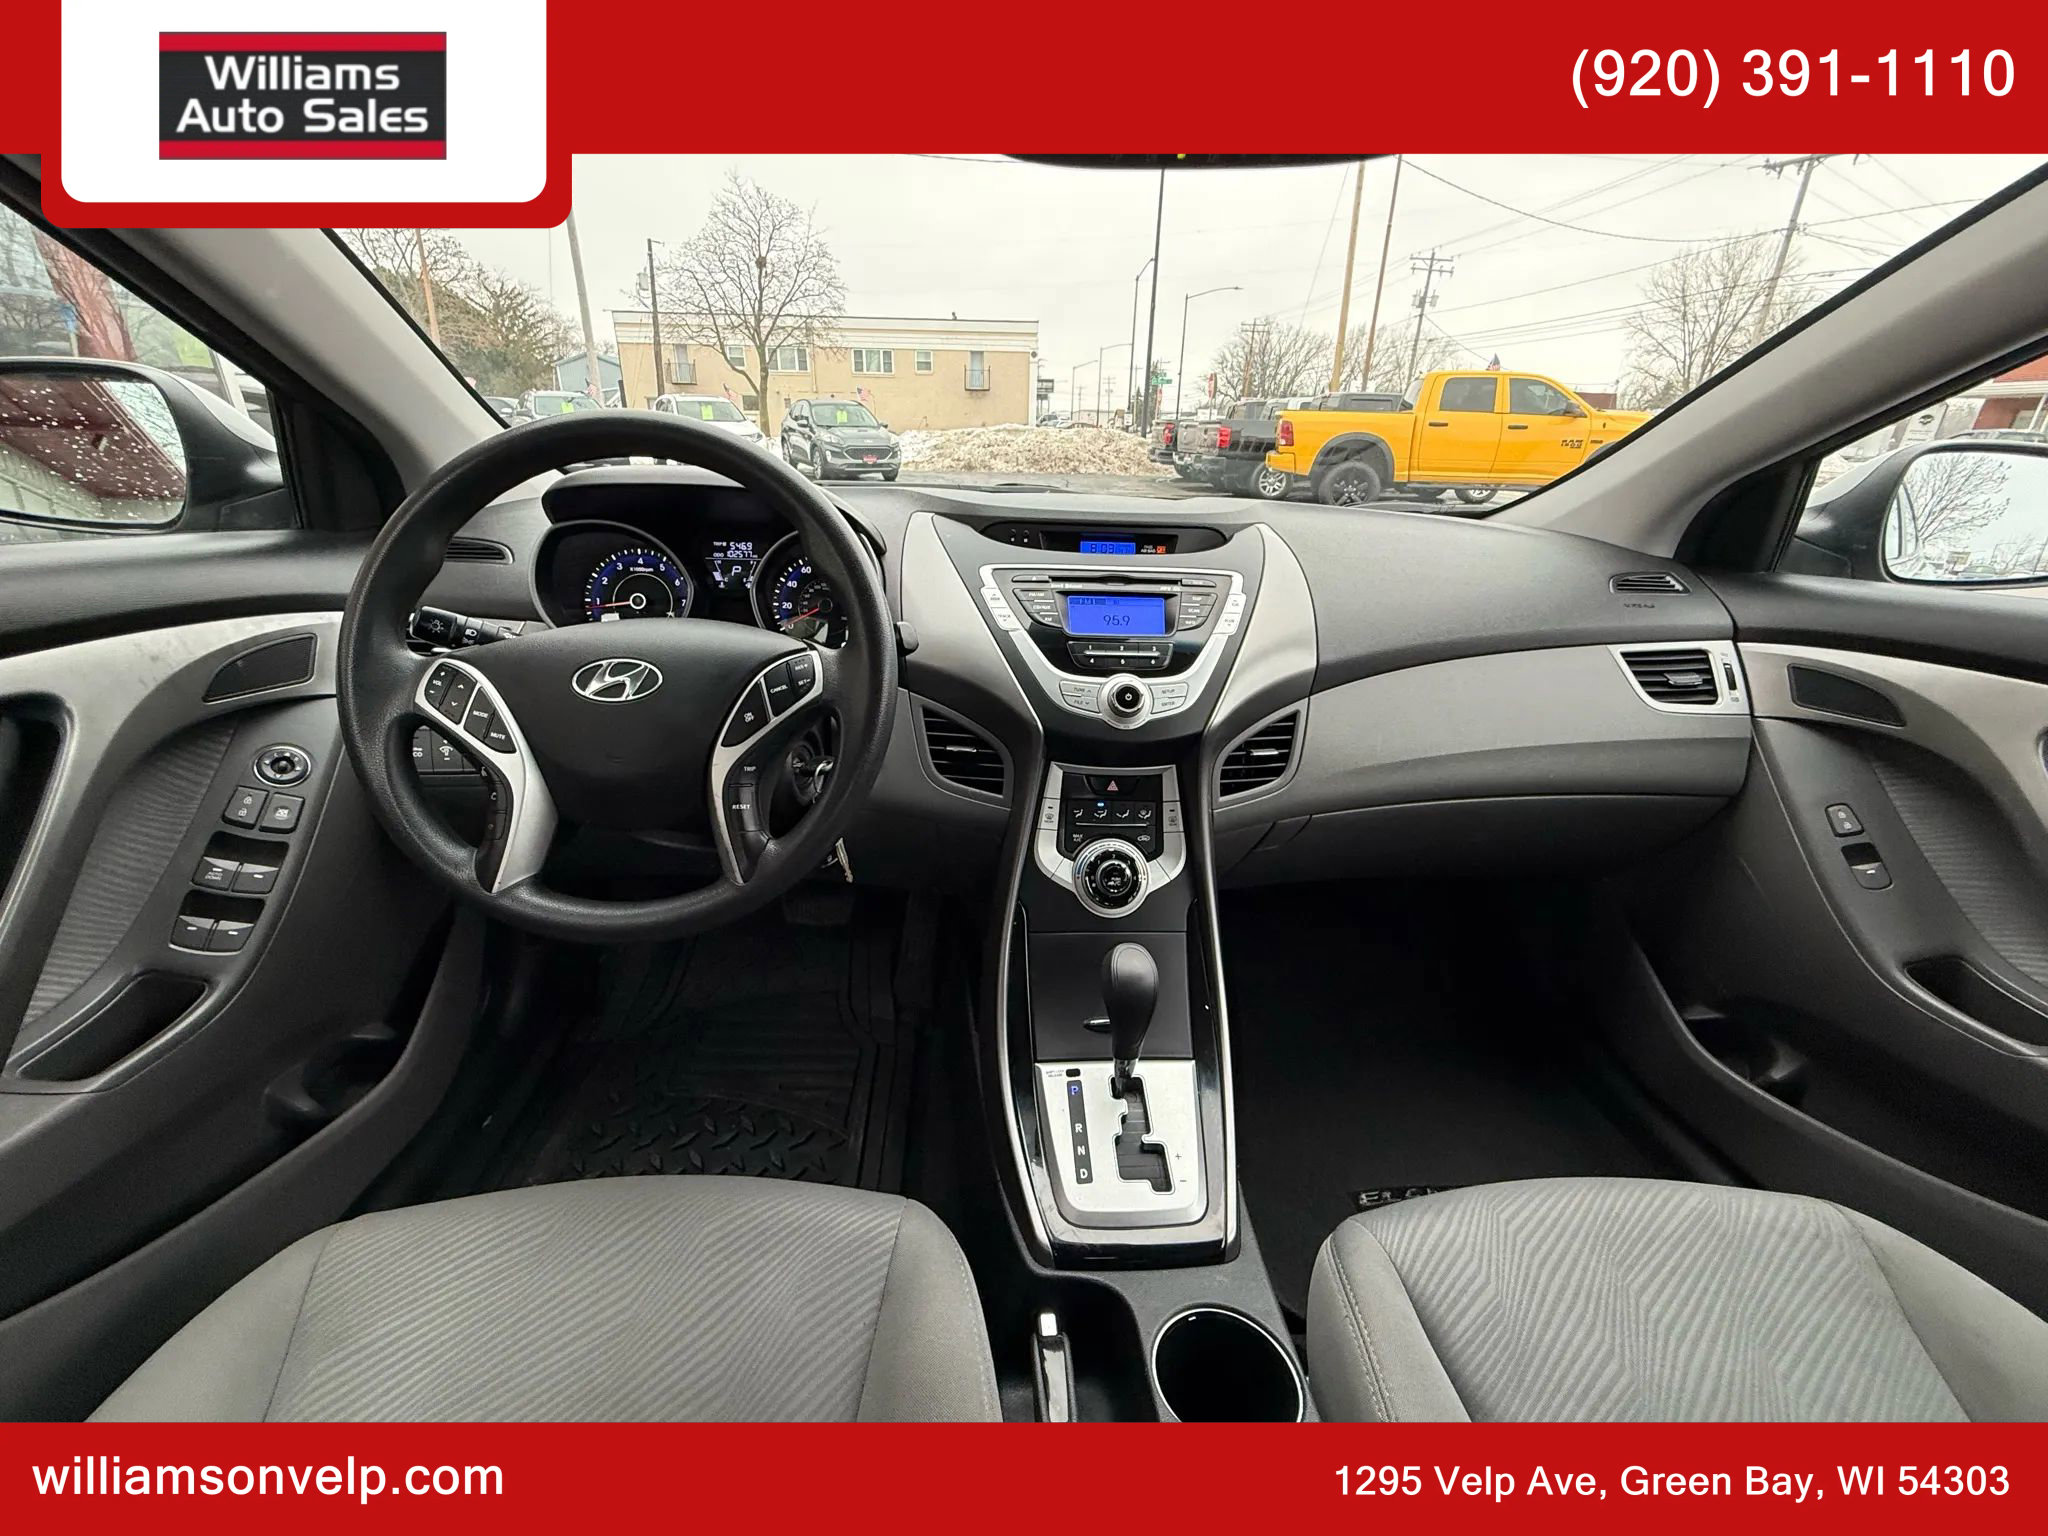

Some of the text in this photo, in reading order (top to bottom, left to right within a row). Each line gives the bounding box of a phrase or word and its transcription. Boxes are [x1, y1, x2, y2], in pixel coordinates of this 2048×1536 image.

[637, 557, 644, 565] 4
[616, 562, 623, 571] 3
[659, 563, 666, 572] 5
[731, 565, 742, 577] P
[801, 566, 812, 574] 60
[601, 576, 608, 585] 2
[674, 578, 680, 586] 6
[786, 580, 798, 588] 40
[782, 602, 793, 610] 20
[1103, 614, 1131, 626] 95.9
[1071, 1085, 1079, 1095] P
[1075, 1124, 1083, 1133] R
[1077, 1146, 1086, 1155] N
[1080, 1169, 1089, 1179] D
